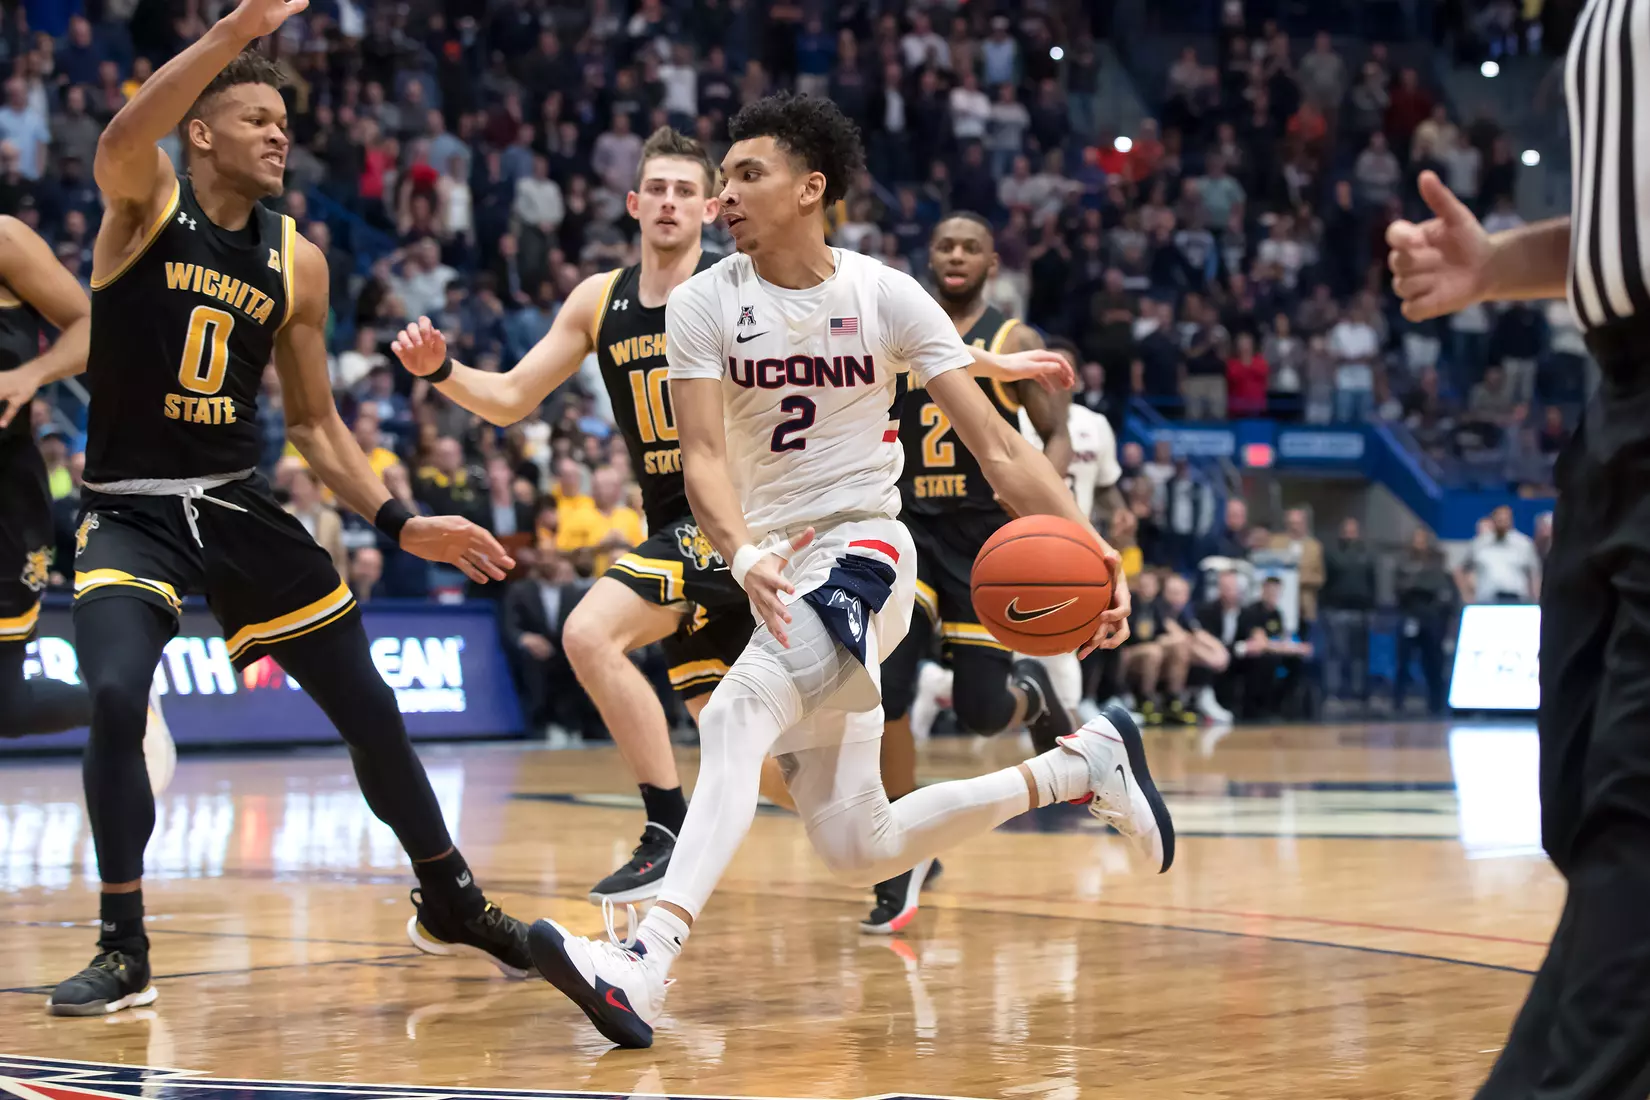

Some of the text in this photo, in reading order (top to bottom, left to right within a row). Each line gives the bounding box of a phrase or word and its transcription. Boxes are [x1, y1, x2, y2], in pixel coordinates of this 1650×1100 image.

[164, 261, 276, 325] WICHITA
[178, 305, 235, 395] 0
[608, 332, 667, 367] WICH
[728, 354, 876, 389] UCONN
[164, 393, 236, 425] STATE
[628, 366, 680, 443] 10
[770, 394, 817, 453] 2
[920, 402, 955, 468] 2
[643, 448, 683, 475] STAT
[913, 474, 968, 499] STATE
